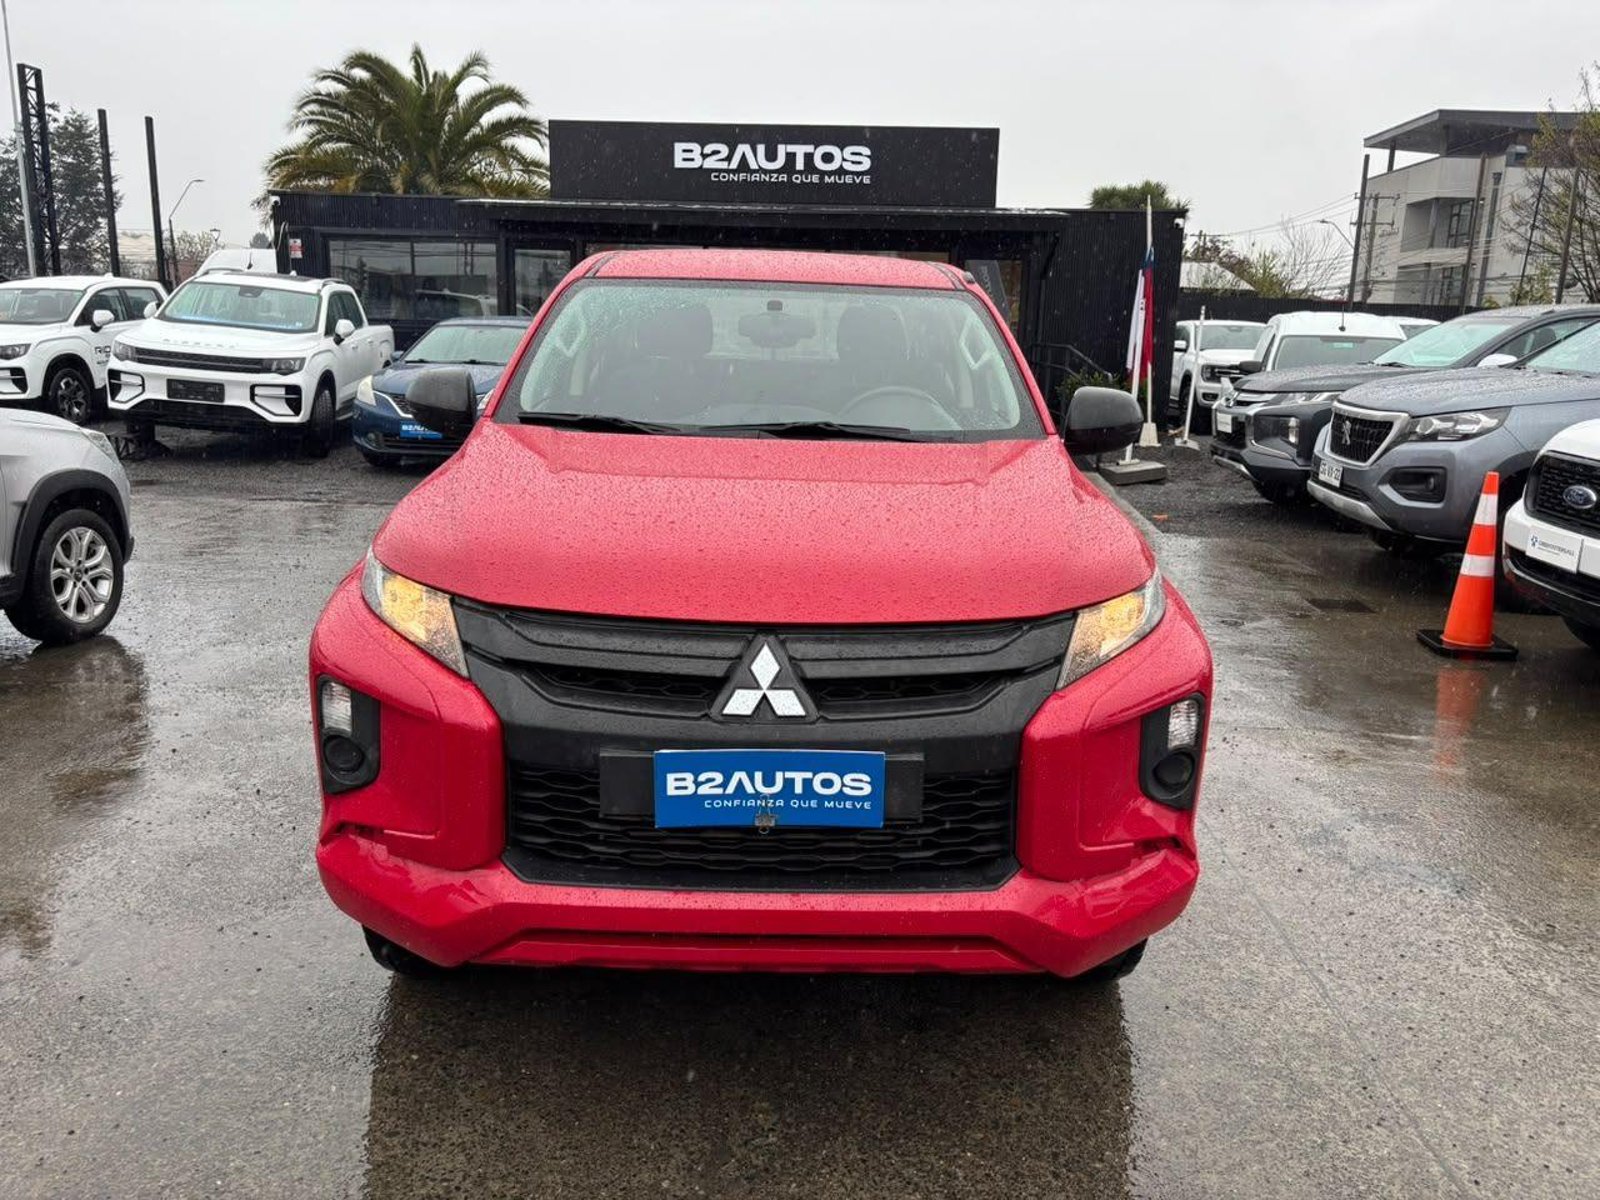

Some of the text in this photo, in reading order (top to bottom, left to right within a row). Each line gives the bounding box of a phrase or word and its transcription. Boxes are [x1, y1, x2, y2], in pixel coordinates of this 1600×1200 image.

[673, 142, 872, 172] B2AUTOS
[710, 171, 872, 185] CONFIANZA QUE MUEVE
[666, 770, 873, 797] B2AUTOS
[704, 798, 873, 811] CONFIANZA QUE MUEVE
